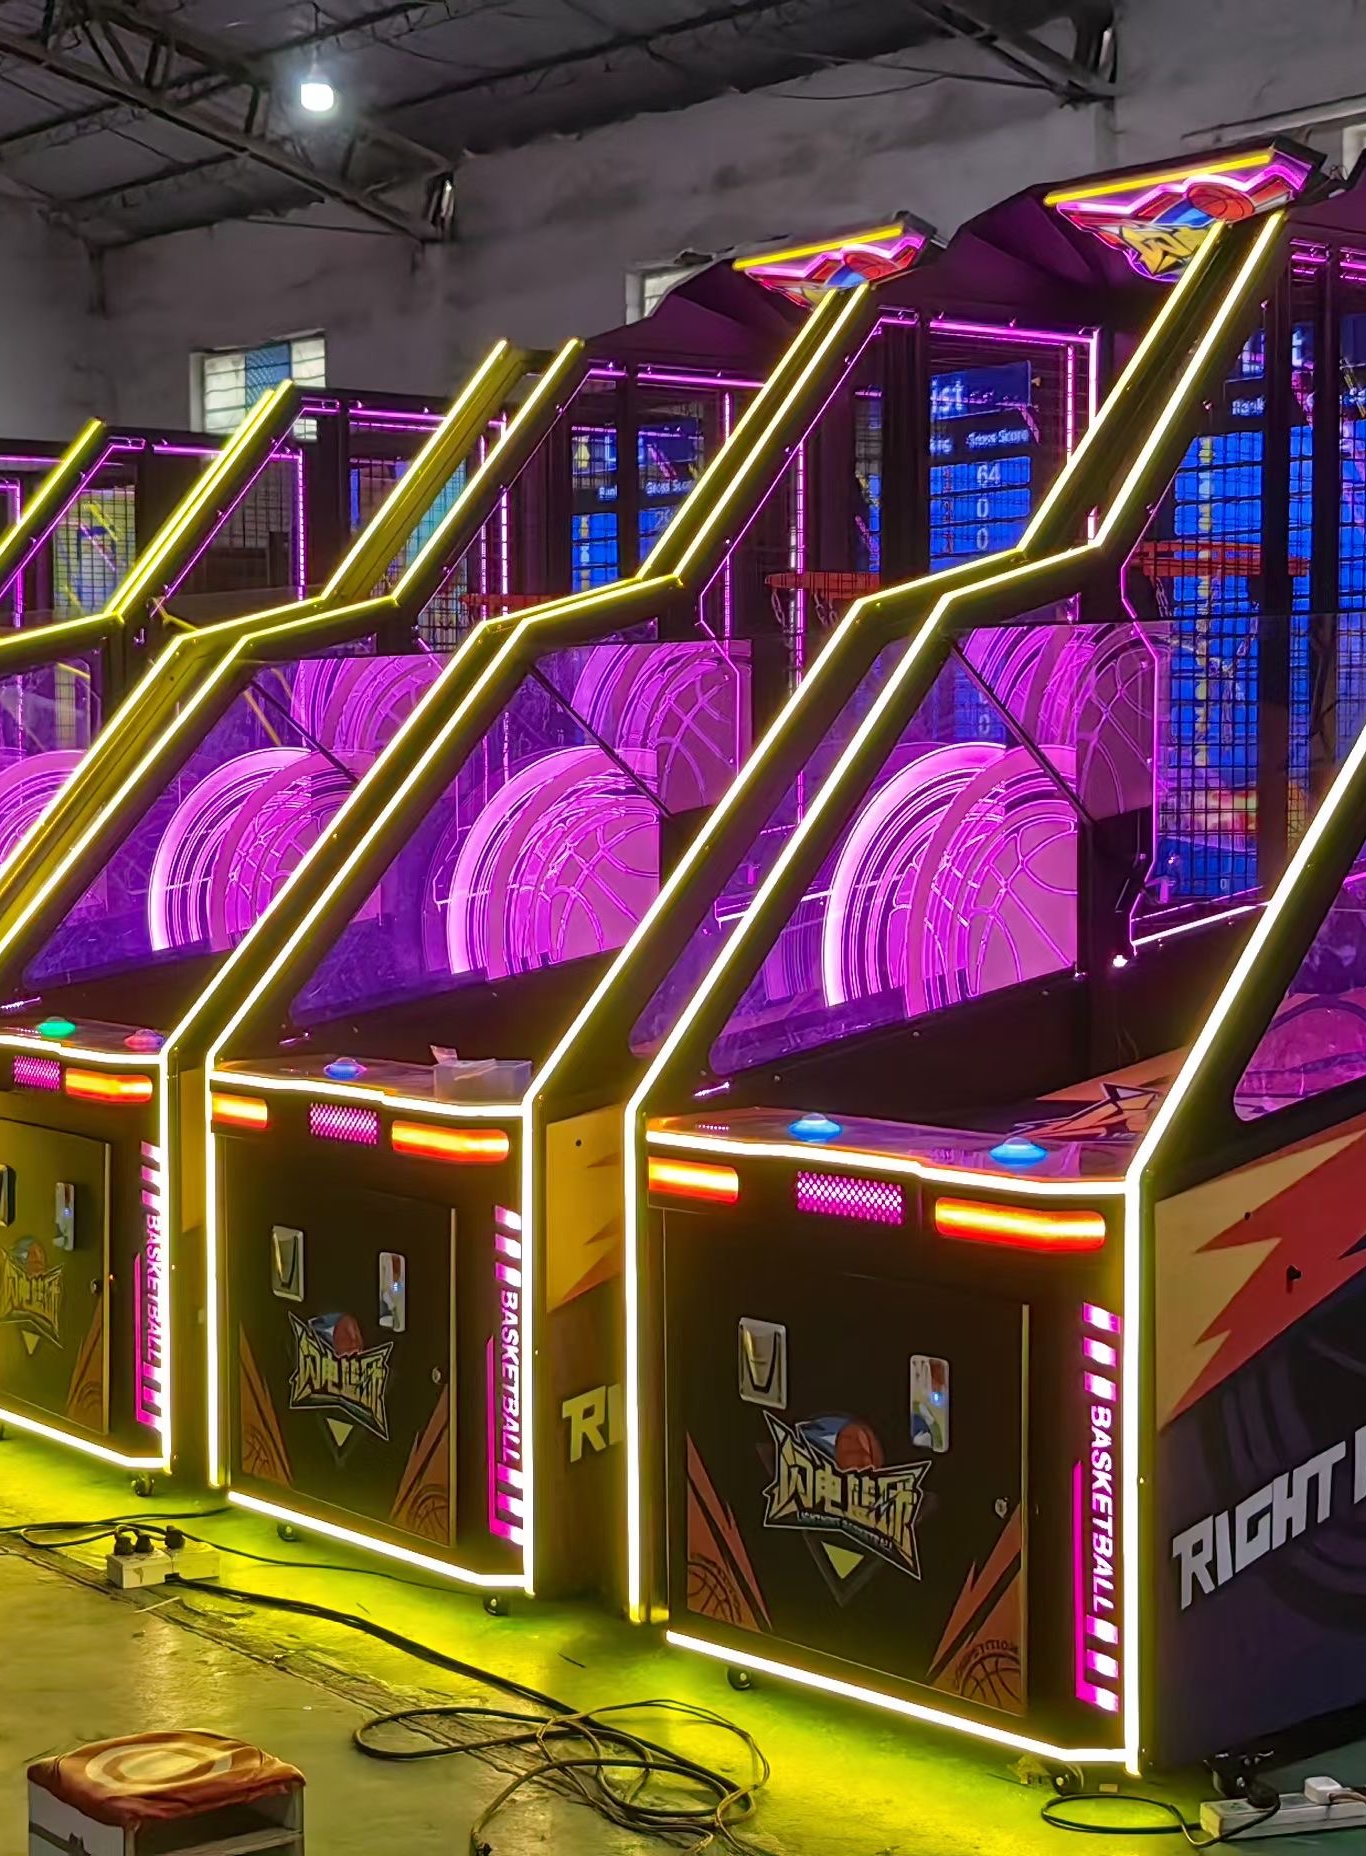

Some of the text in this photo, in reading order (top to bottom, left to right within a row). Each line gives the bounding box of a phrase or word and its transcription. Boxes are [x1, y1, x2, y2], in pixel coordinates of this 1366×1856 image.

[500, 1289, 522, 1464] BASKETBALL
[1090, 1404, 1115, 1613] BASKETBALL
[1172, 1440, 1347, 1610] RIGHT
